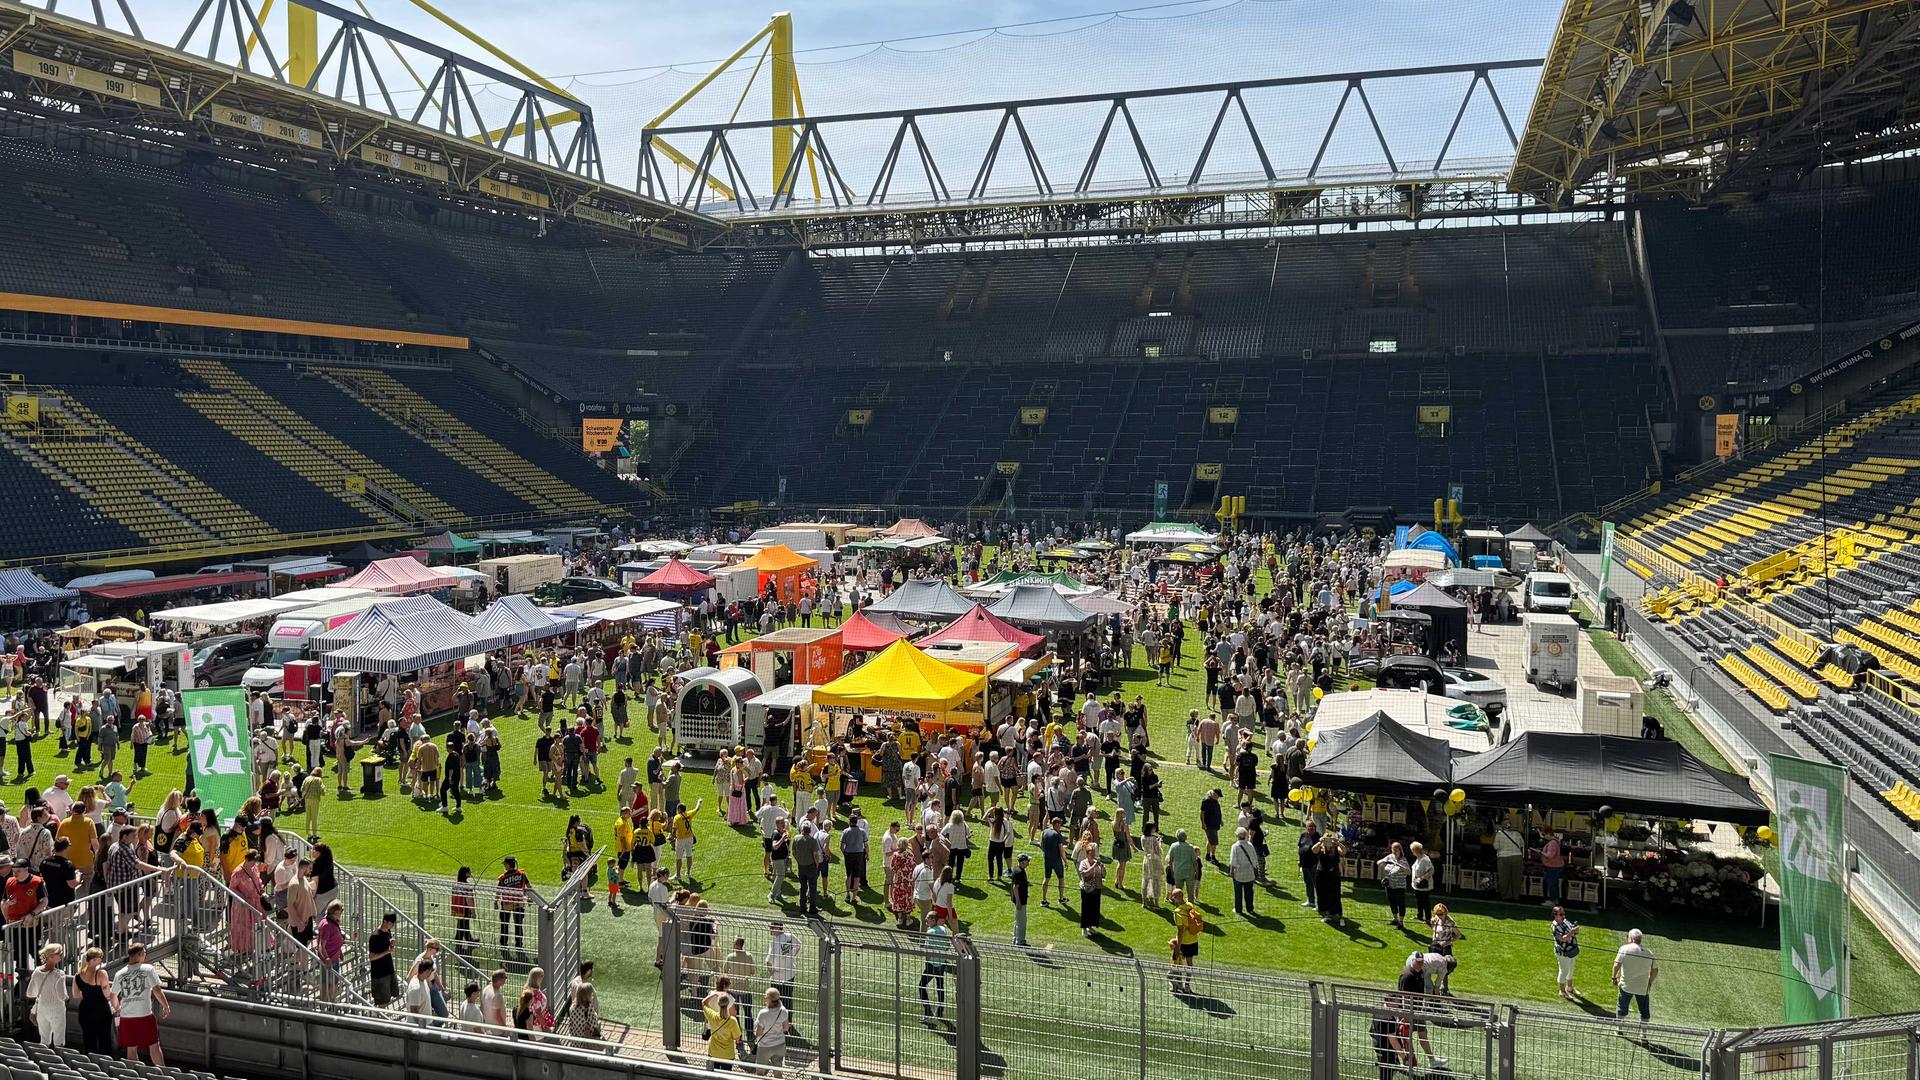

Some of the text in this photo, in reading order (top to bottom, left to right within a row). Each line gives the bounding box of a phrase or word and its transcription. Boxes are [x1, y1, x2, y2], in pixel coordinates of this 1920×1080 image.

[38, 62, 59, 77] 1997
[105, 79, 124, 94] 1997
[229, 111, 247, 126] 2002
[279, 125, 295, 138] 2011
[374, 151, 389, 162] 2012
[1809, 353, 1863, 384] SIGNAL IDUNA
[903, 612, 932, 620] WINEBOX
[1014, 618, 1043, 626] WINEBOX
[818, 703, 865, 716] WAFFELN
[906, 737, 912, 747] 4
[503, 873, 522, 885] atlas
